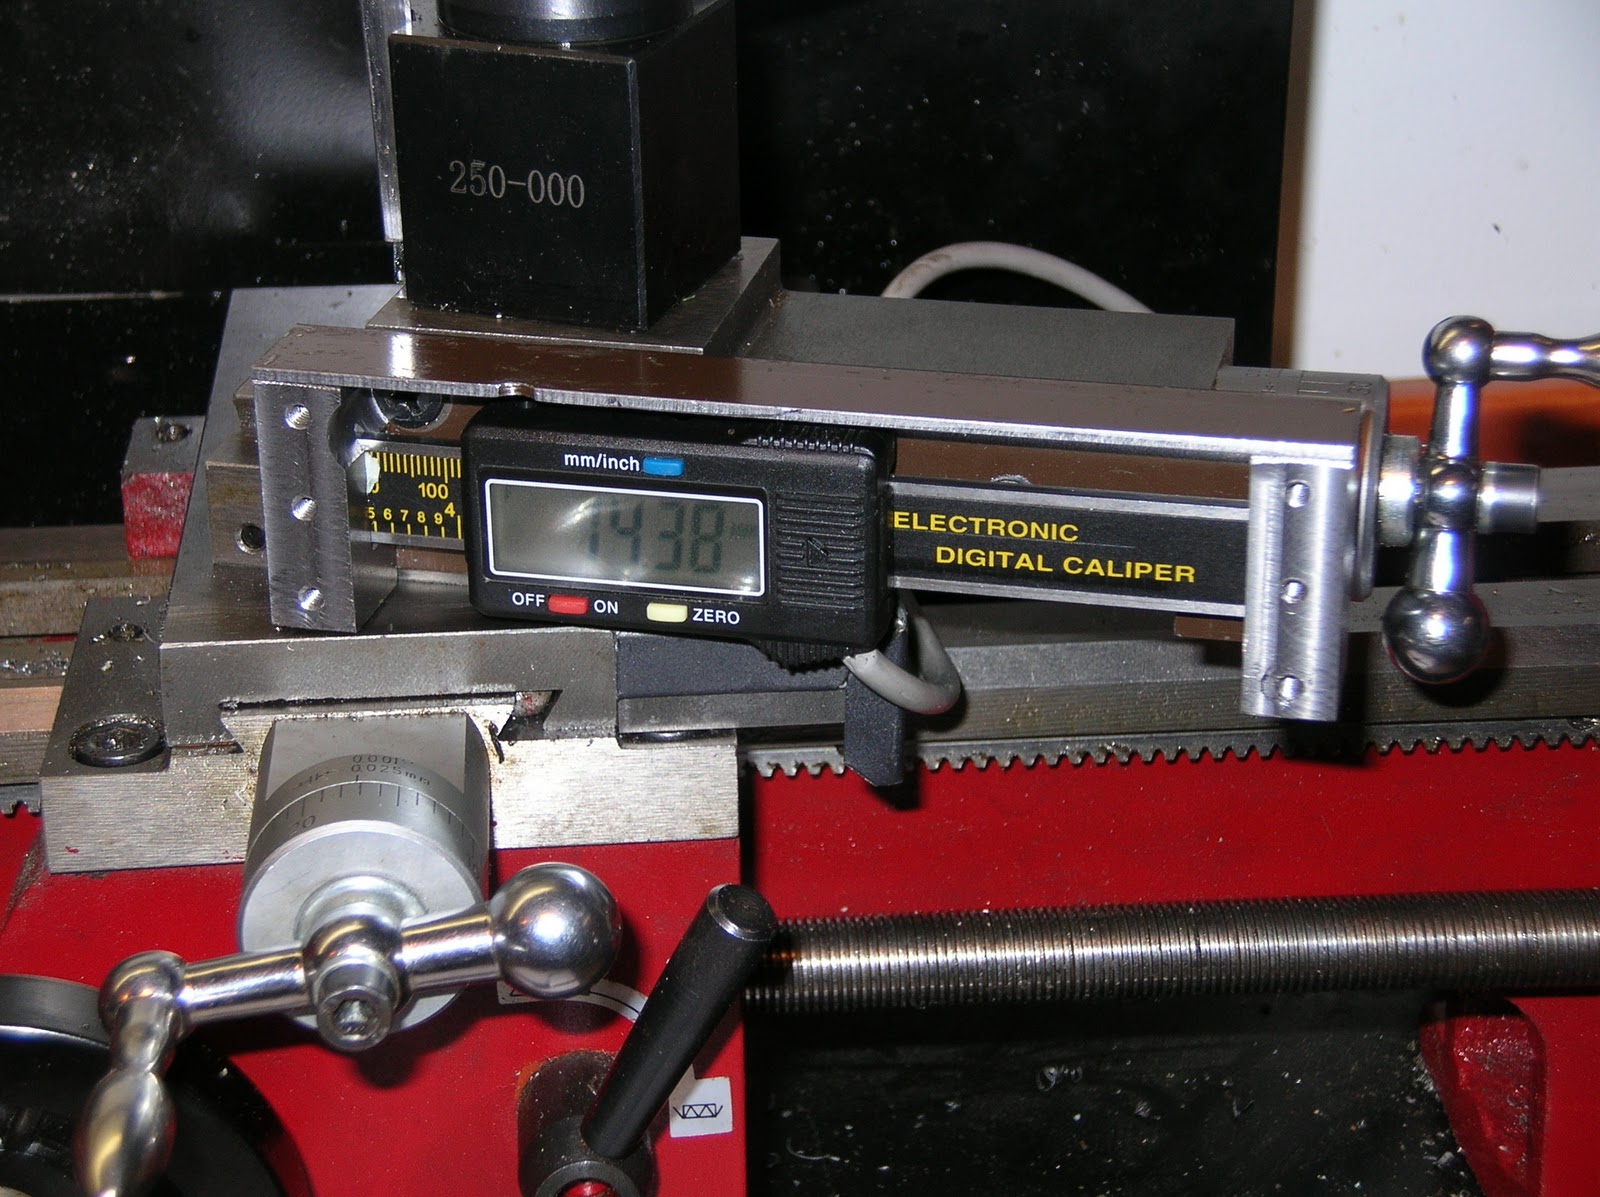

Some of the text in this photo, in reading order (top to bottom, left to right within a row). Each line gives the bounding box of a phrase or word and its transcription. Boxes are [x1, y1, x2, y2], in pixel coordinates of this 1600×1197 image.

[449, 159, 585, 208] 250-000
[564, 453, 640, 471] mm/inch
[418, 482, 449, 500] 100
[383, 507, 392, 520] 6
[400, 509, 409, 522] 7
[417, 511, 426, 524] 8
[434, 512, 443, 525] 9
[444, 501, 457, 518] 4
[893, 511, 1079, 542] ELECTRONIC
[936, 546, 1195, 583] DIGITAL CALIPER
[512, 591, 545, 607] OFF
[594, 600, 619, 614] ON
[692, 608, 740, 625] ZERO
